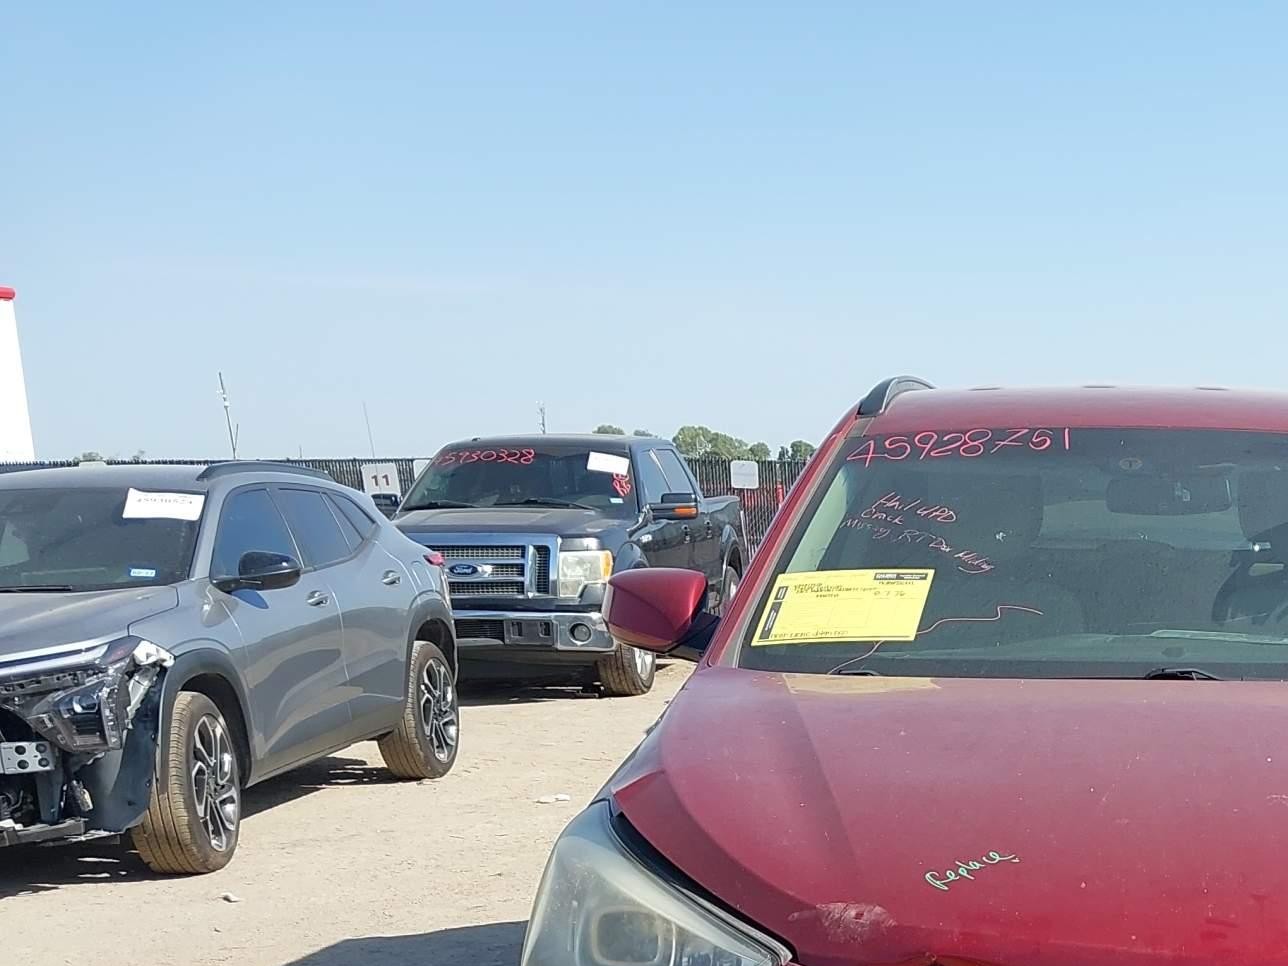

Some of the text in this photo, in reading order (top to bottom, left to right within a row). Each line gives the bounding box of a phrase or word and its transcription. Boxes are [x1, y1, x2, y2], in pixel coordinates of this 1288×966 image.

[847, 428, 1070, 467] 45928751
[371, 474, 391, 487] 11
[871, 491, 921, 511] Hail
[861, 508, 905, 525] Crack
